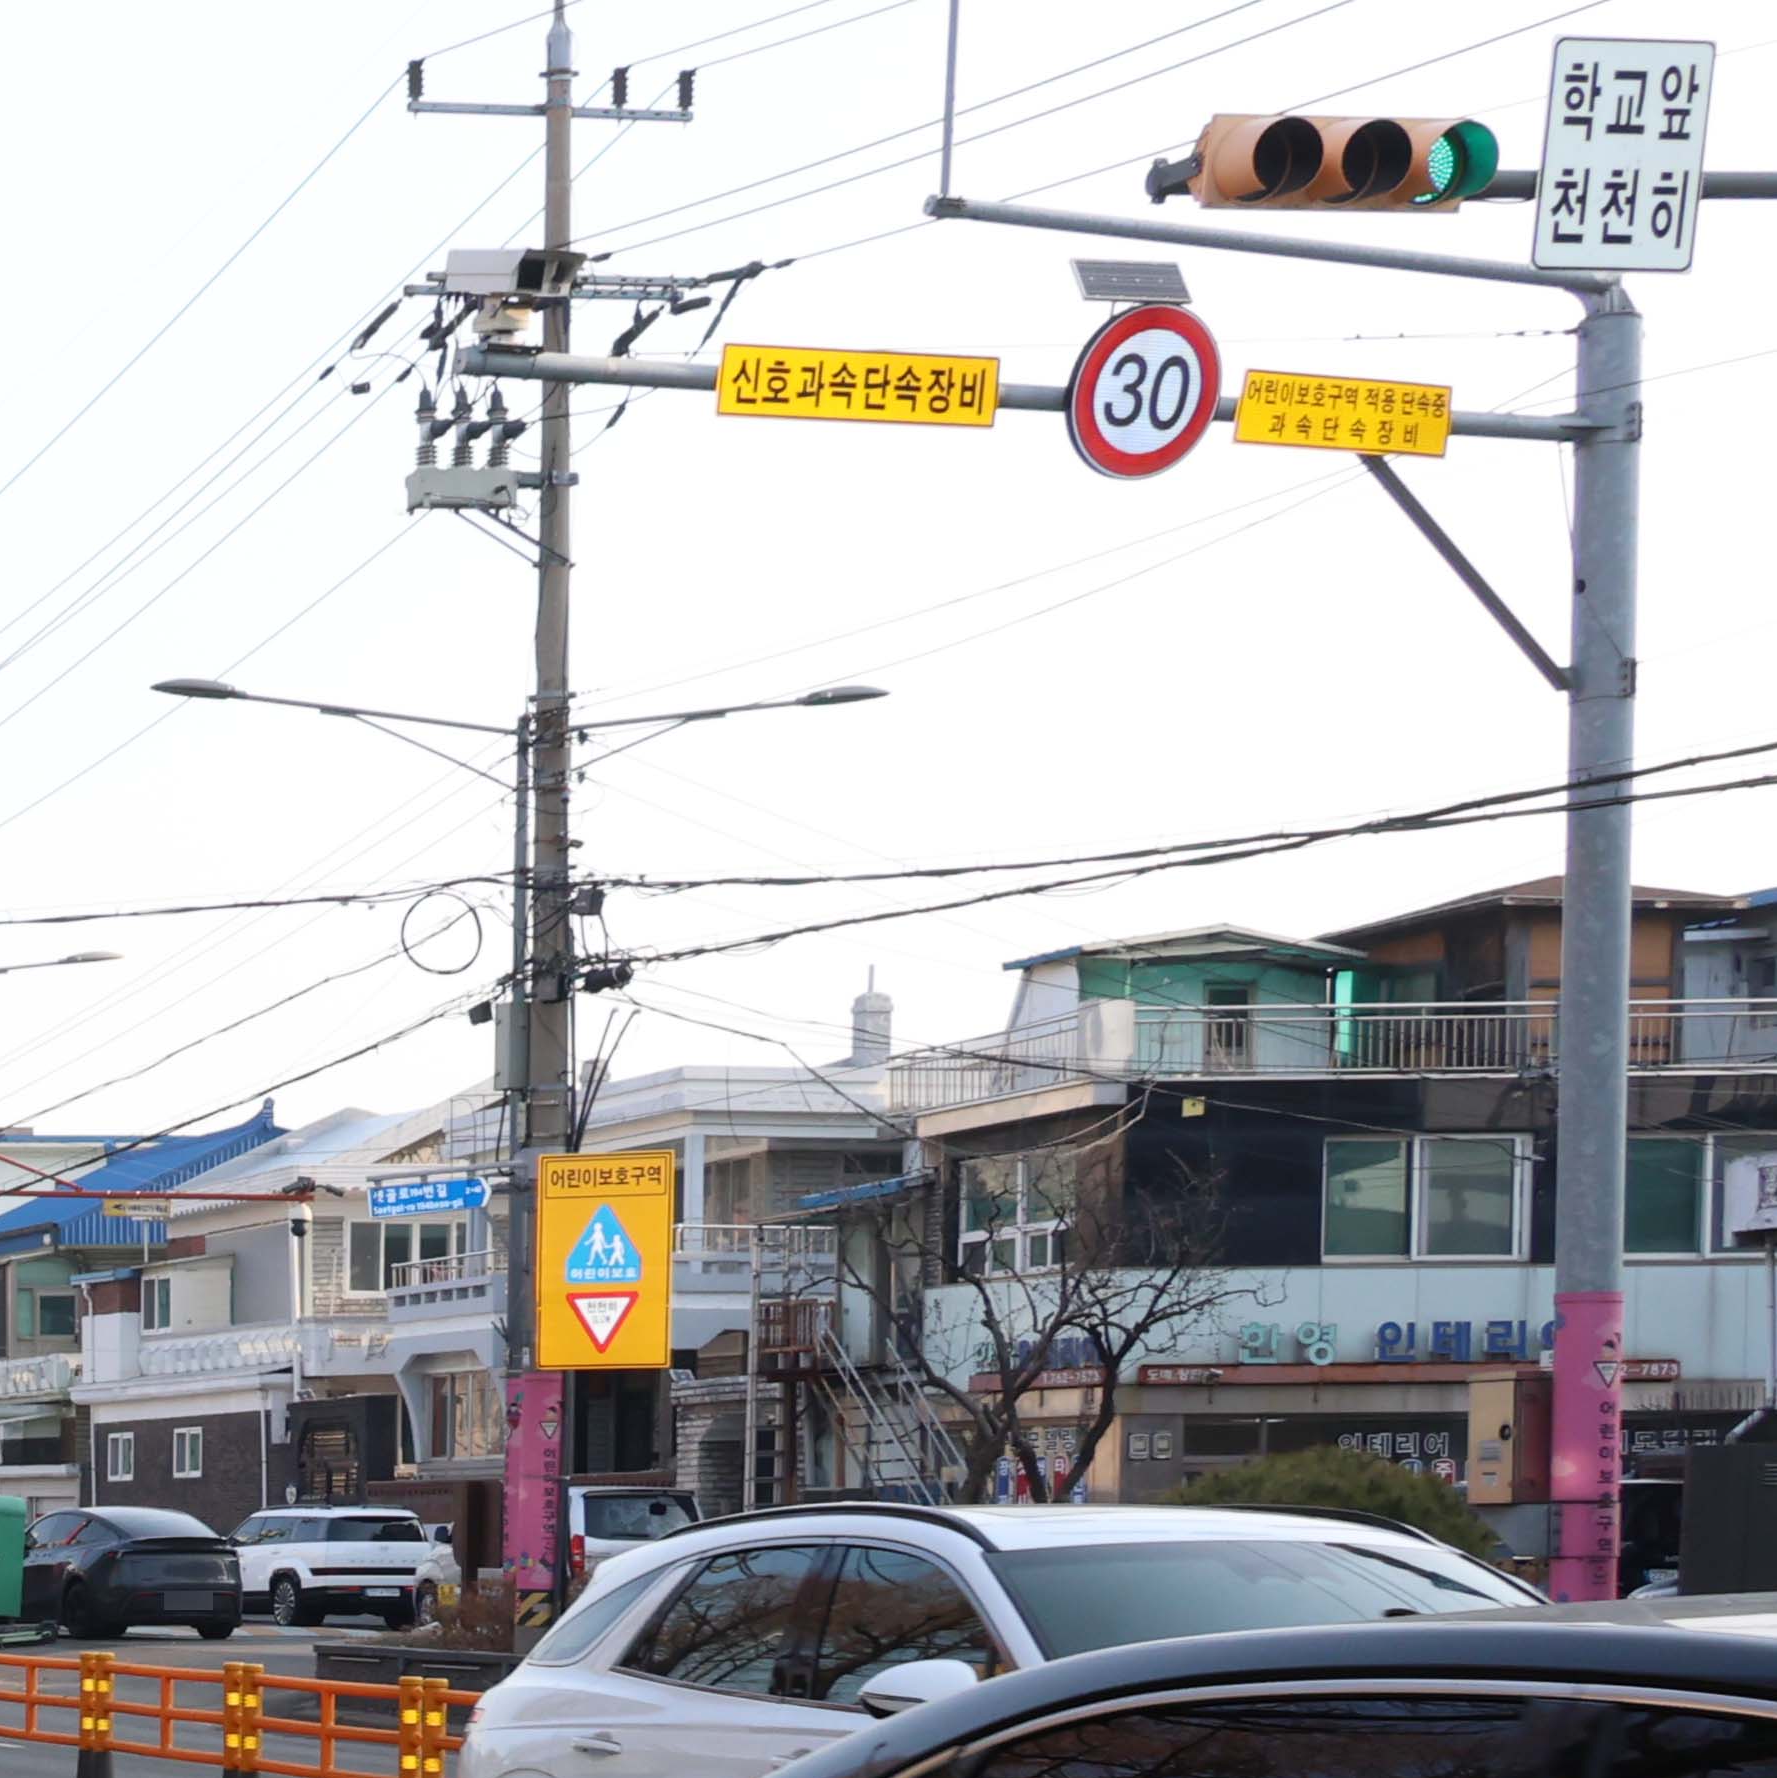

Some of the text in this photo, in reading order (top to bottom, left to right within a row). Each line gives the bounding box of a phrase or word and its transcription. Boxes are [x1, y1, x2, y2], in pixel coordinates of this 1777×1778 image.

[1562, 62, 1700, 142] 학교앞
[1549, 165, 1686, 251] 천천히
[732, 357, 987, 416] 신호과속단속장비
[1103, 354, 1189, 430] 30
[1247, 379, 1446, 418] 어린이보호구역 적용 단속중
[1268, 412, 1419, 447] 과속단속장비
[550, 1166, 662, 1189] 어린이보호구역
[570, 1267, 638, 1281] 어린이보호
[1239, 1322, 1337, 1366] 한영
